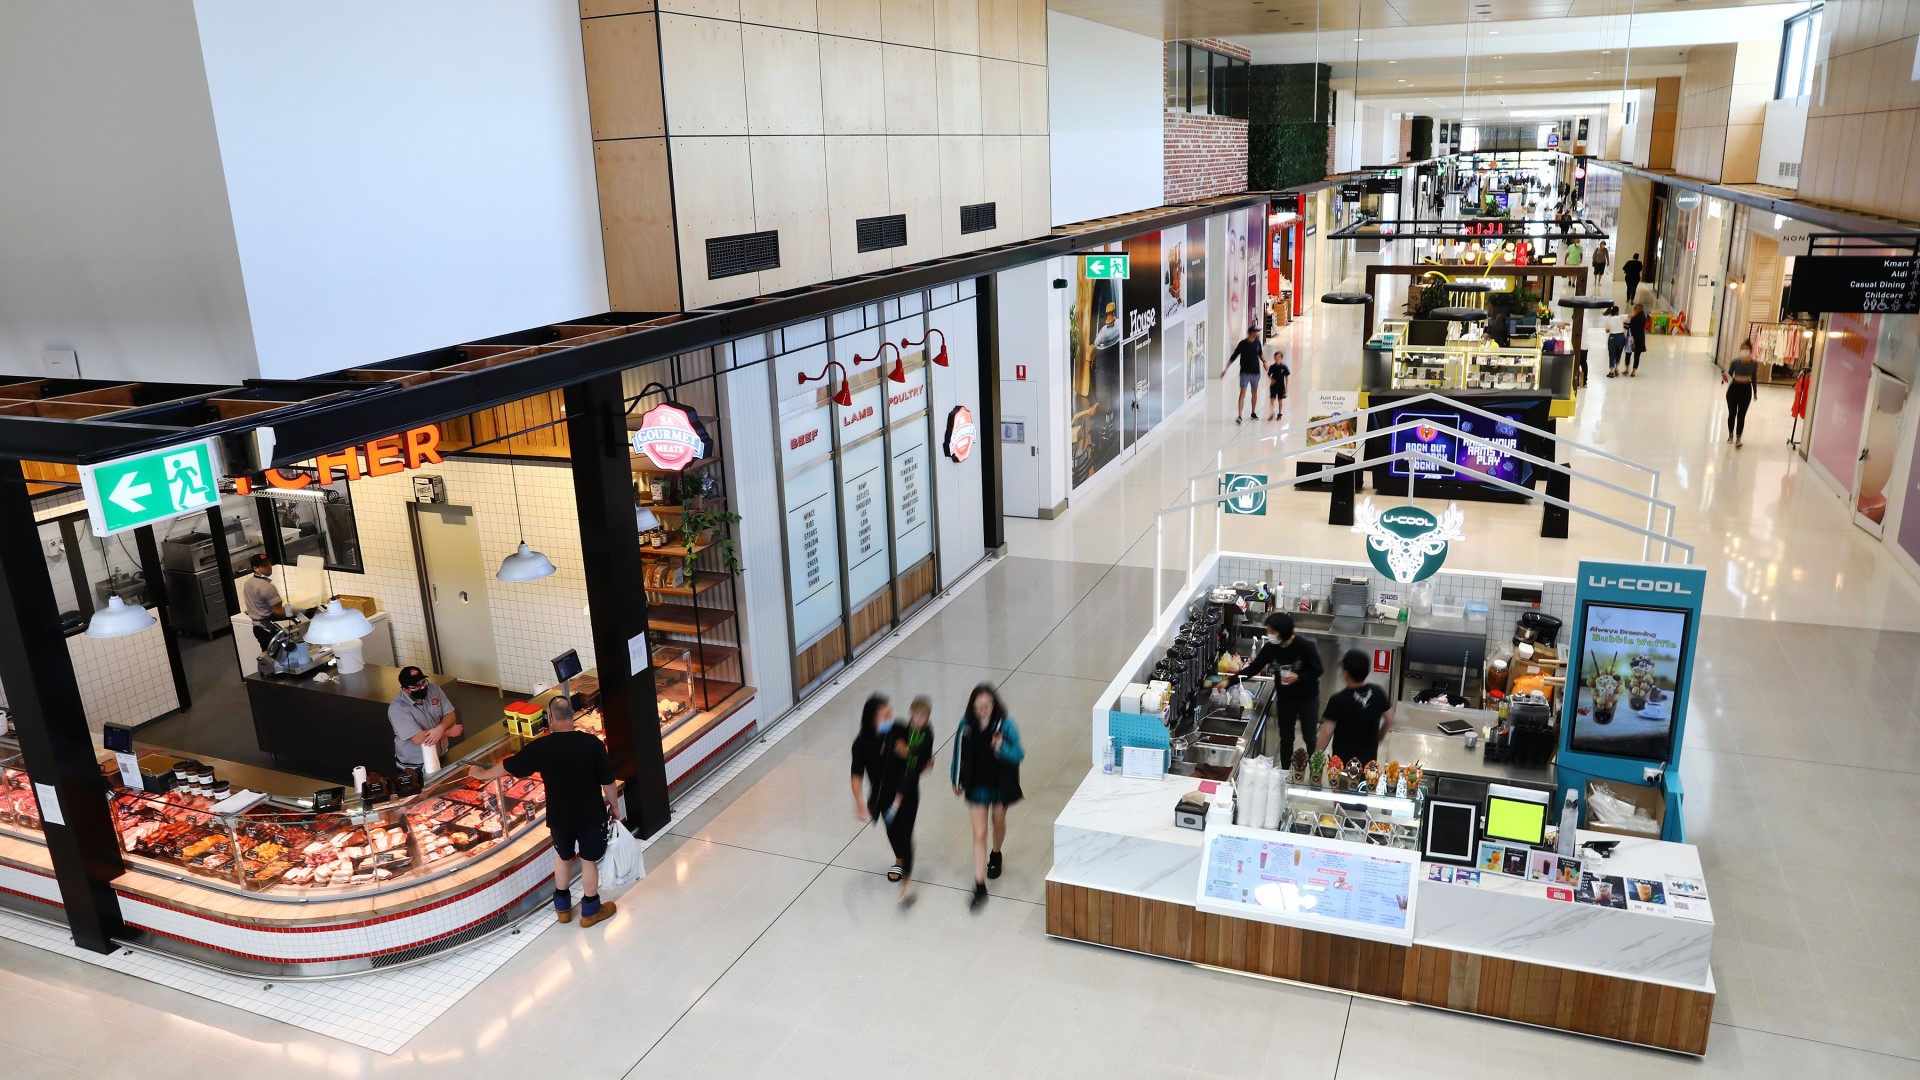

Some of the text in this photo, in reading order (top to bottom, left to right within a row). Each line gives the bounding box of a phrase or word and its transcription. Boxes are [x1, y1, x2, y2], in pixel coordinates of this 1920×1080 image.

[1884, 260, 1910, 268] Kmart
[1880, 281, 1906, 289] Dining
[1130, 308, 1156, 337] House
[888, 384, 924, 408] POULTRY
[660, 415, 674, 426] SA
[843, 406, 874, 427] LAMB
[638, 429, 699, 445] GOURMET
[790, 428, 818, 450] BEEF
[655, 444, 684, 453] MEATS
[1405, 442, 1447, 453] ROCK OUT
[1467, 446, 1496, 456] ARMS
[1476, 456, 1500, 465] PLAY
[1383, 514, 1434, 527] U-COOL
[1588, 575, 1692, 595] U-COOL
[1589, 626, 1619, 634] Always
[1592, 633, 1677, 649] Bubble Waffle
